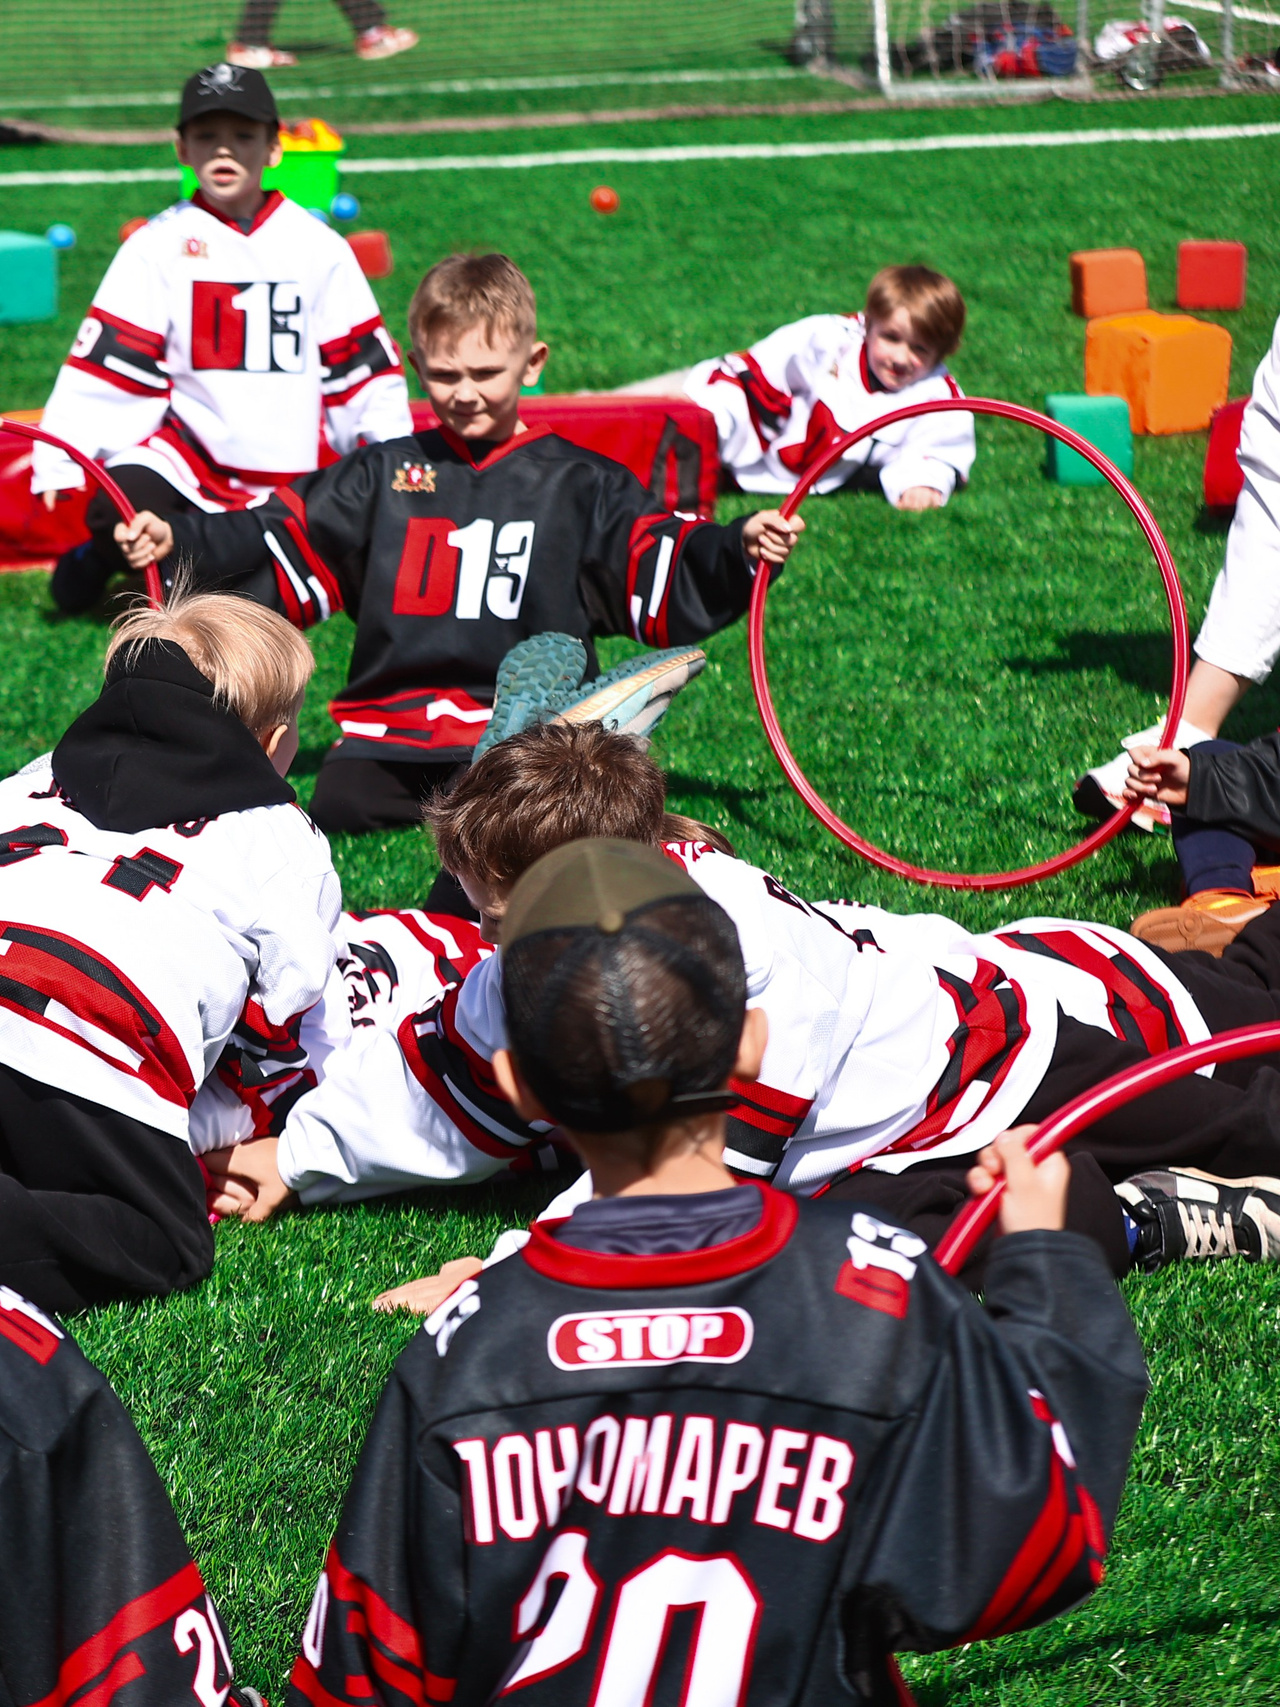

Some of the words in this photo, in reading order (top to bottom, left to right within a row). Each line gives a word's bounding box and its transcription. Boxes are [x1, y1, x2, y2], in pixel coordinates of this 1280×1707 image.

[191, 279, 306, 373] D13
[392, 516, 536, 621] D13
[574, 1313, 724, 1364] STOP
